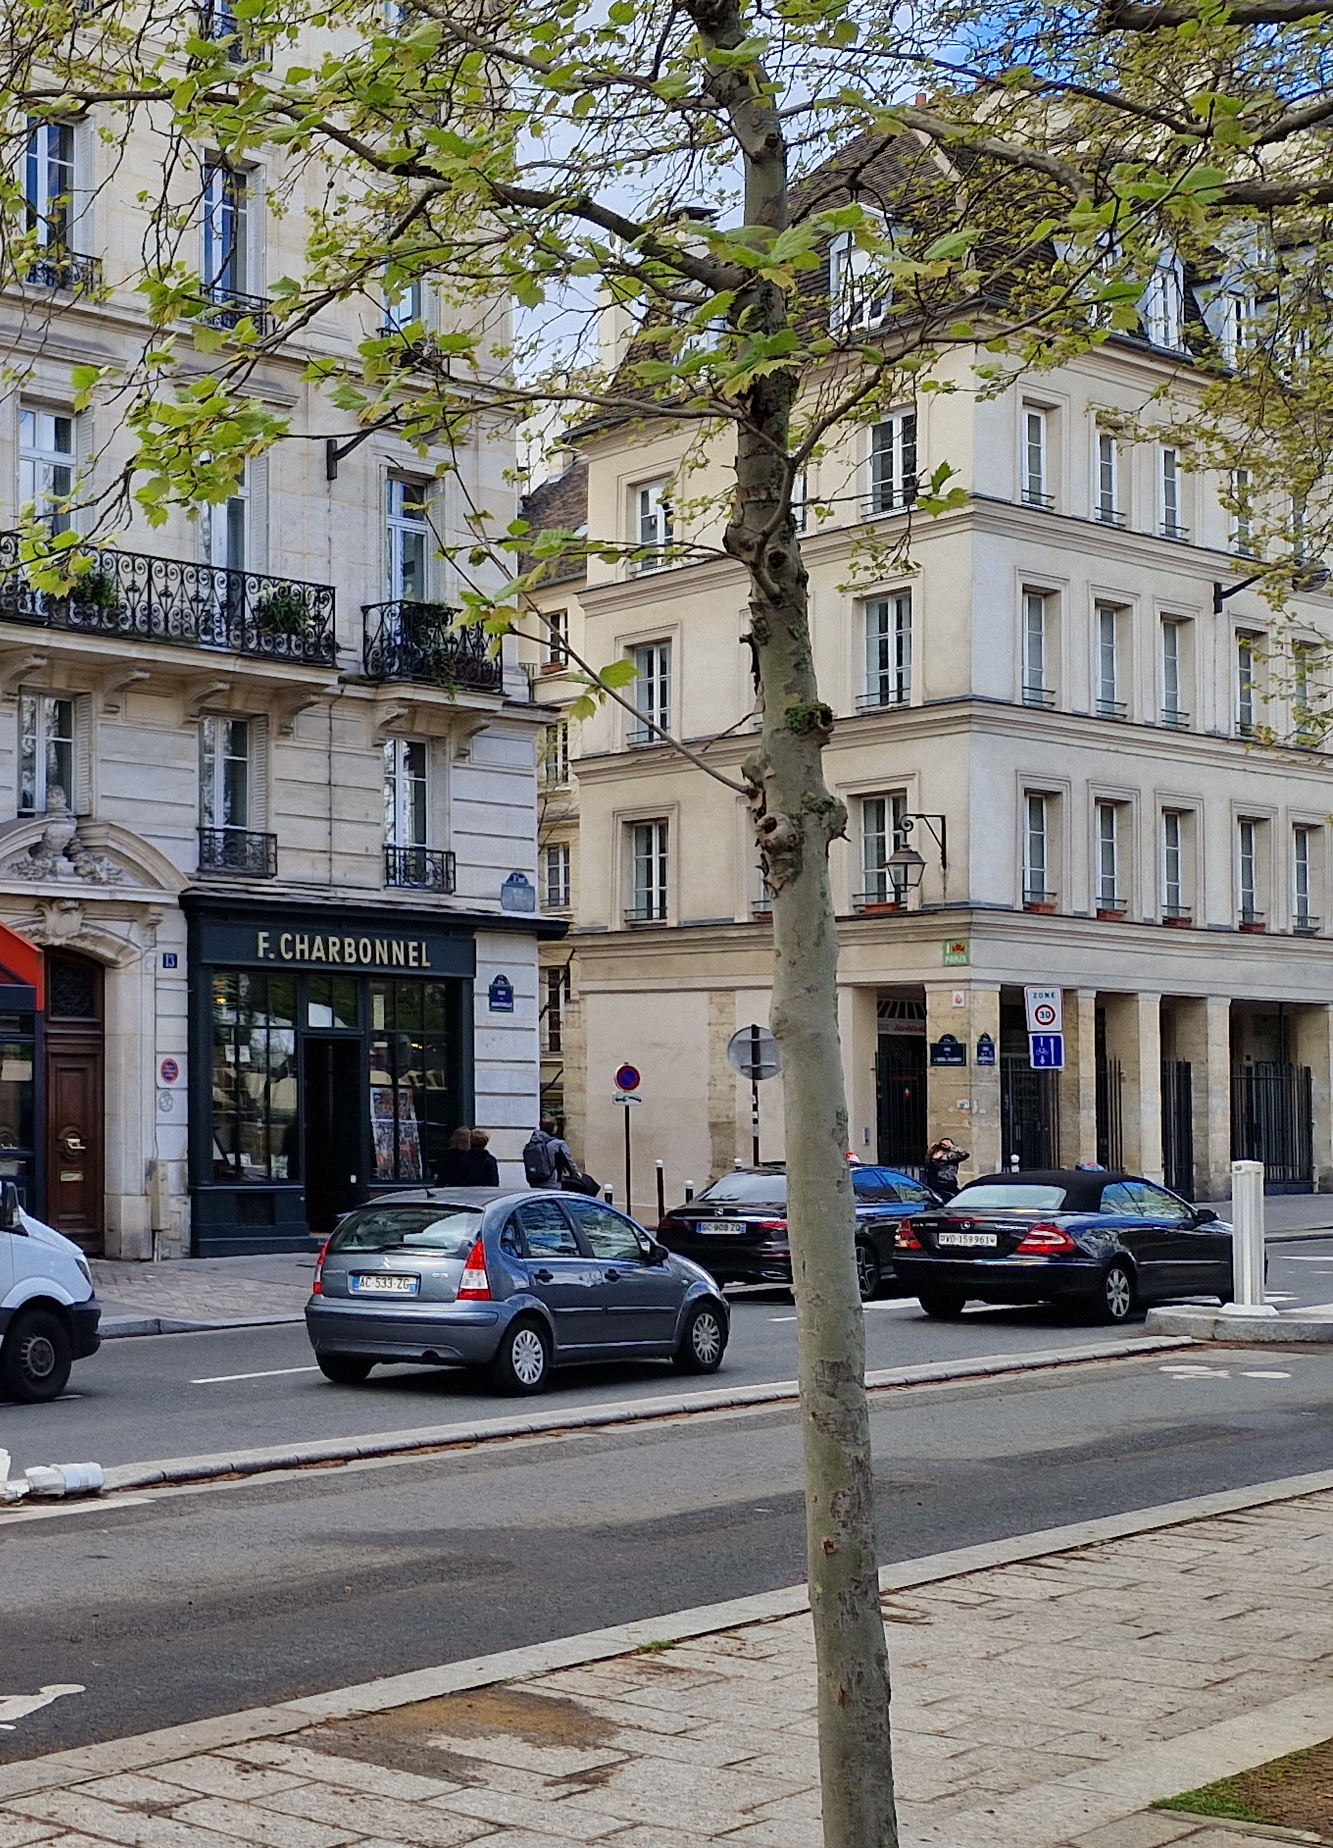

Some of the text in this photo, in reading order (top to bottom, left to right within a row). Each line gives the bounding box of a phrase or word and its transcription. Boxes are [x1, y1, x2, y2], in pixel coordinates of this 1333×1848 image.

[279, 932, 431, 968] CHARBONNEL
[165, 953, 176, 968] 13
[1033, 991, 1056, 999] ZONE
[1039, 1010, 1052, 1019] 30
